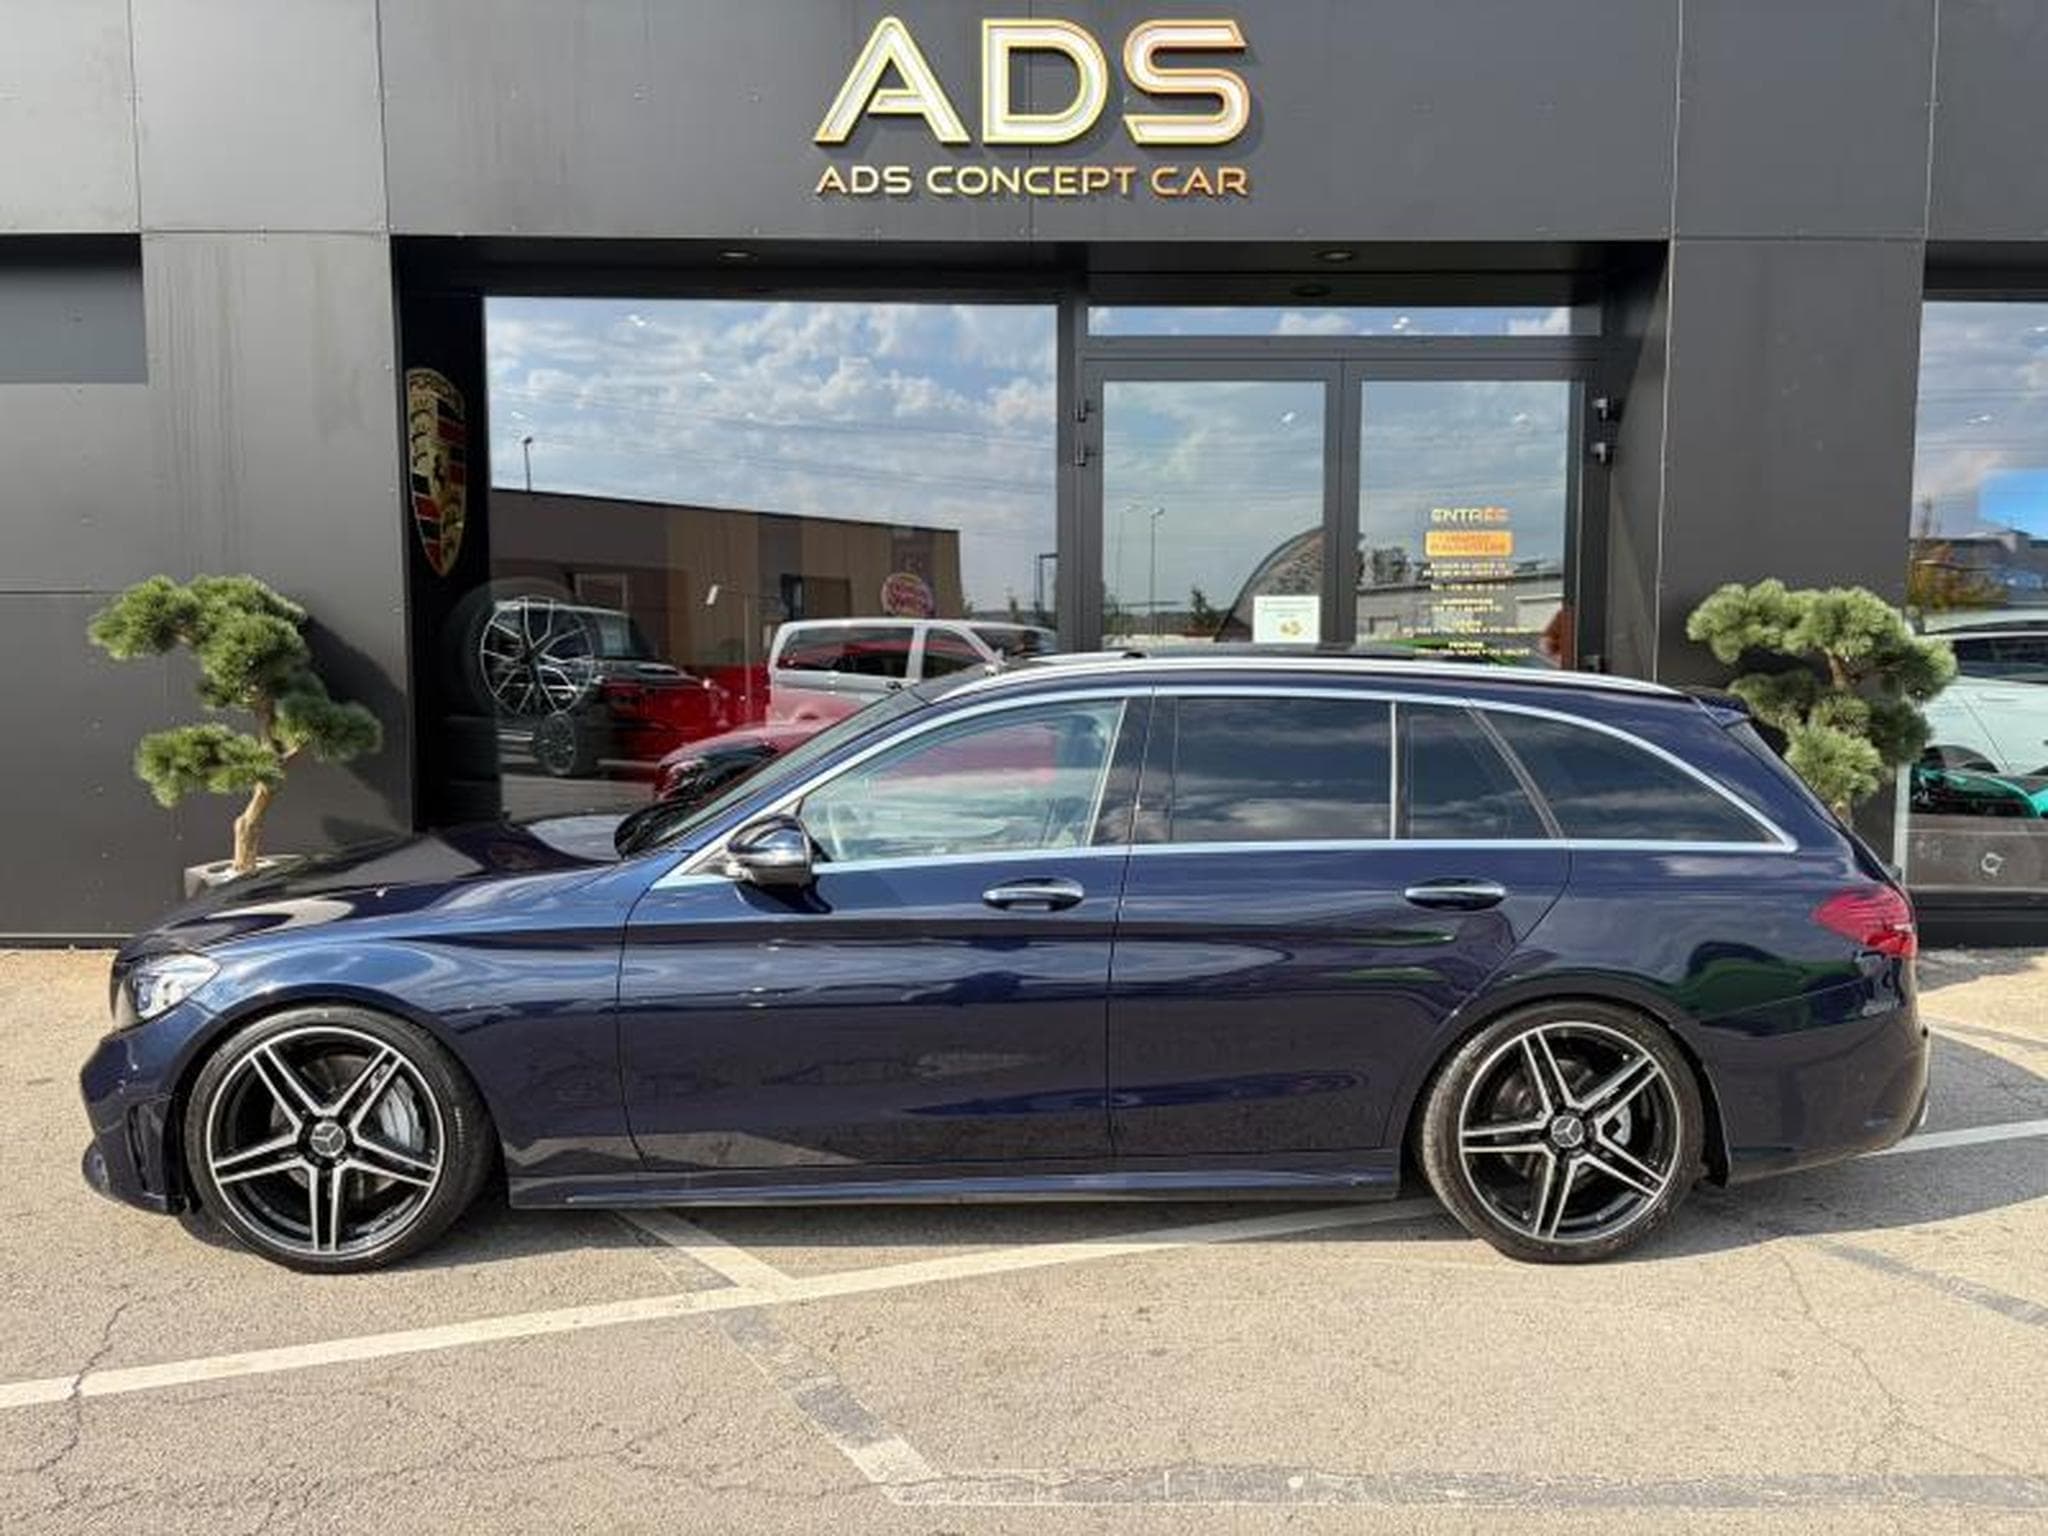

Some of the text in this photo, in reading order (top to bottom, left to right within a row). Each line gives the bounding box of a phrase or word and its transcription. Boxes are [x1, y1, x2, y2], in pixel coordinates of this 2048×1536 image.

[813, 16, 1251, 145] ADS
[815, 165, 1249, 197] ADS CONCEPT CAR
